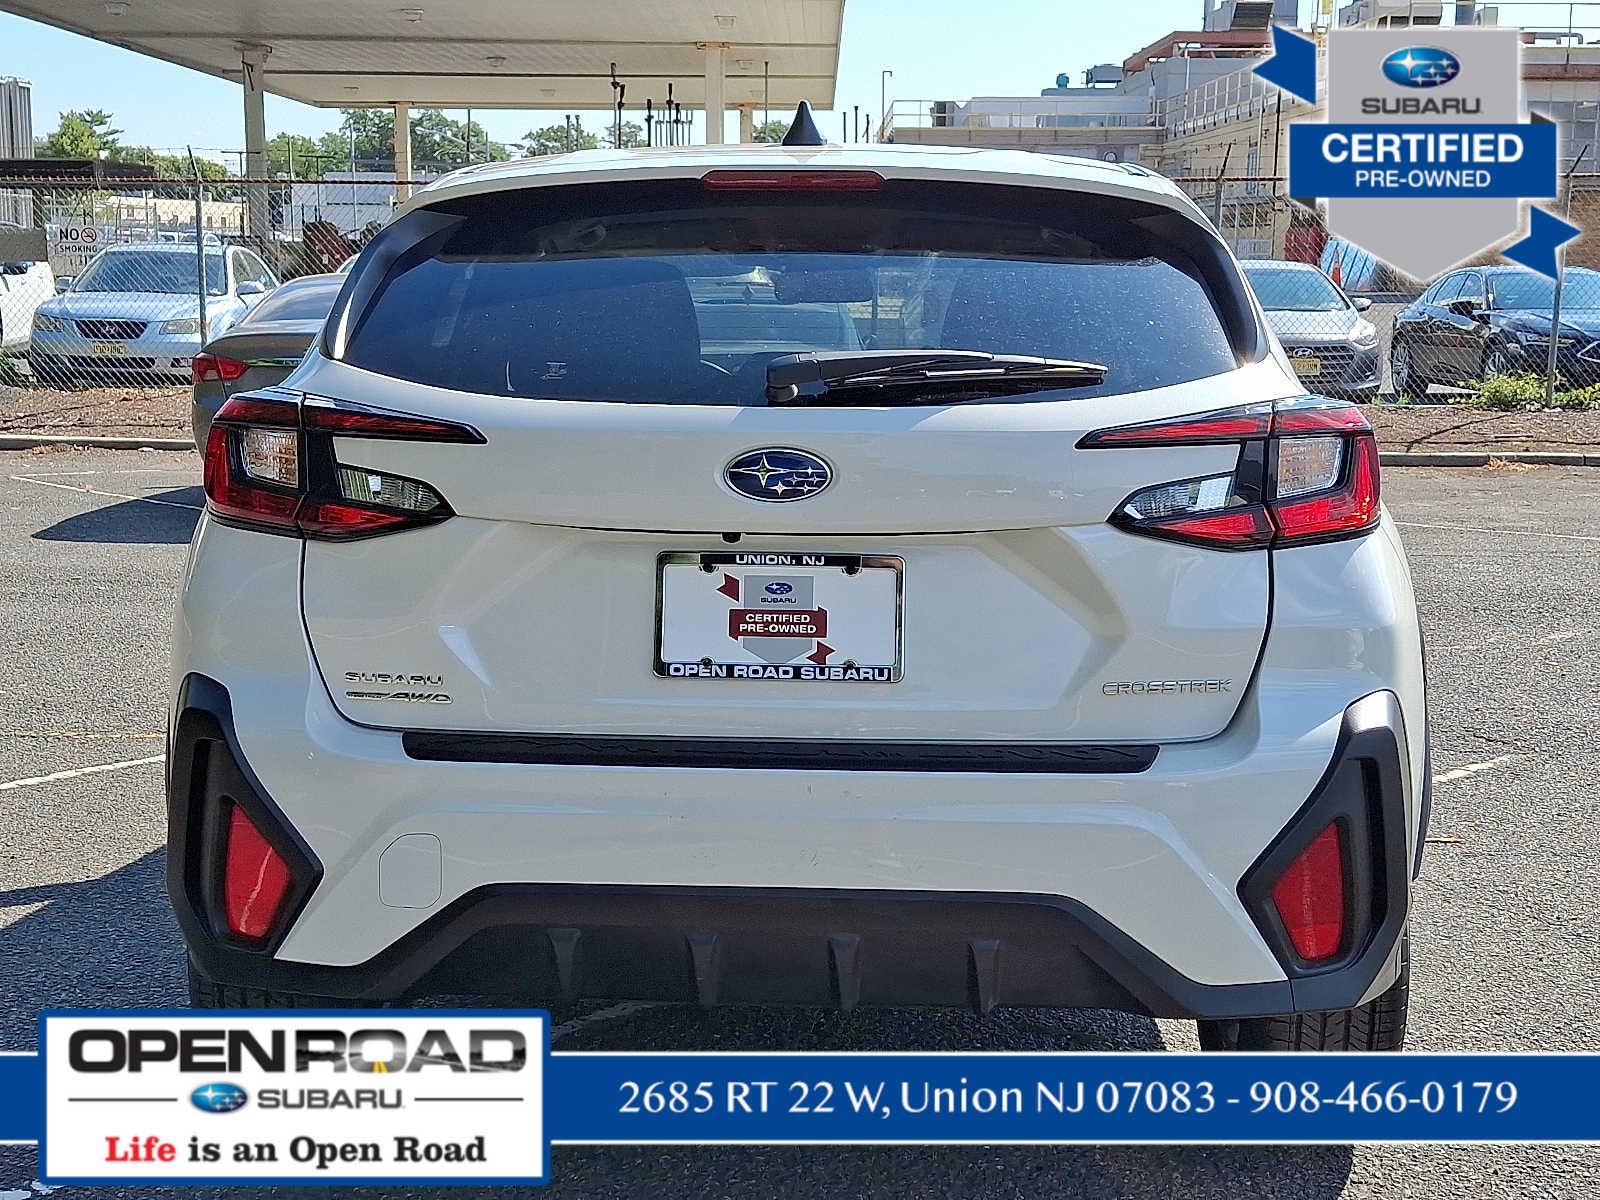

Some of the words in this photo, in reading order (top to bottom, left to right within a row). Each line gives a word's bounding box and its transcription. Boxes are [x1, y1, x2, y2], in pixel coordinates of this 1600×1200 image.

[59, 228, 80, 241] NO
[59, 244, 98, 254] SMOKING
[735, 553, 797, 566] UNION,
[801, 554, 826, 566] NJ
[760, 596, 797, 604] SUBARU
[745, 613, 811, 624] CERTIFIED
[739, 623, 817, 634] PRE-OWNED
[345, 671, 443, 687] SUBARU
[669, 663, 727, 678] OPEN
[733, 664, 794, 680] ROAD
[800, 666, 890, 682] SUBARU
[1102, 679, 1233, 696] CROSSTREK
[387, 691, 453, 704] AWD
